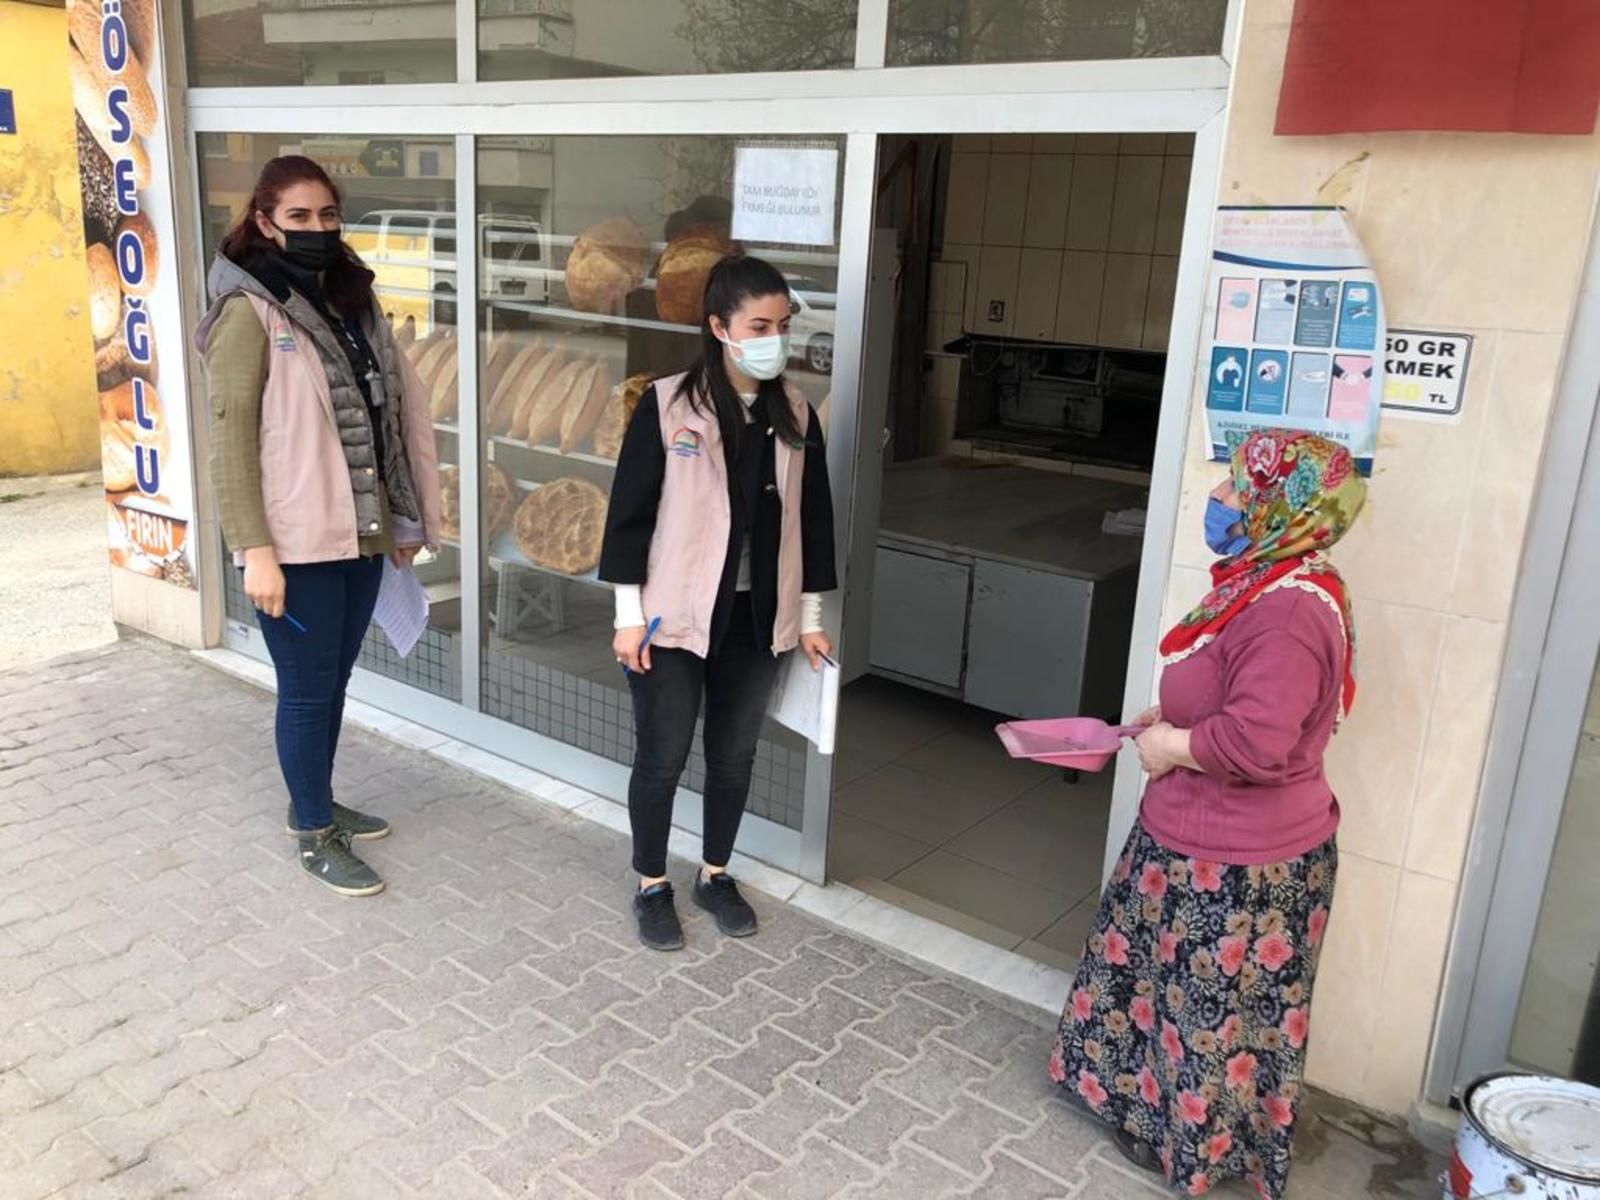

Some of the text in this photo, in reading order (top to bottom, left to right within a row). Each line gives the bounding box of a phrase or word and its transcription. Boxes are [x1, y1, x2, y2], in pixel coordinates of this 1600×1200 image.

[1417, 340, 1457, 358] GR
[1428, 392, 1449, 405] TL
[126, 509, 174, 551] FIRIN
